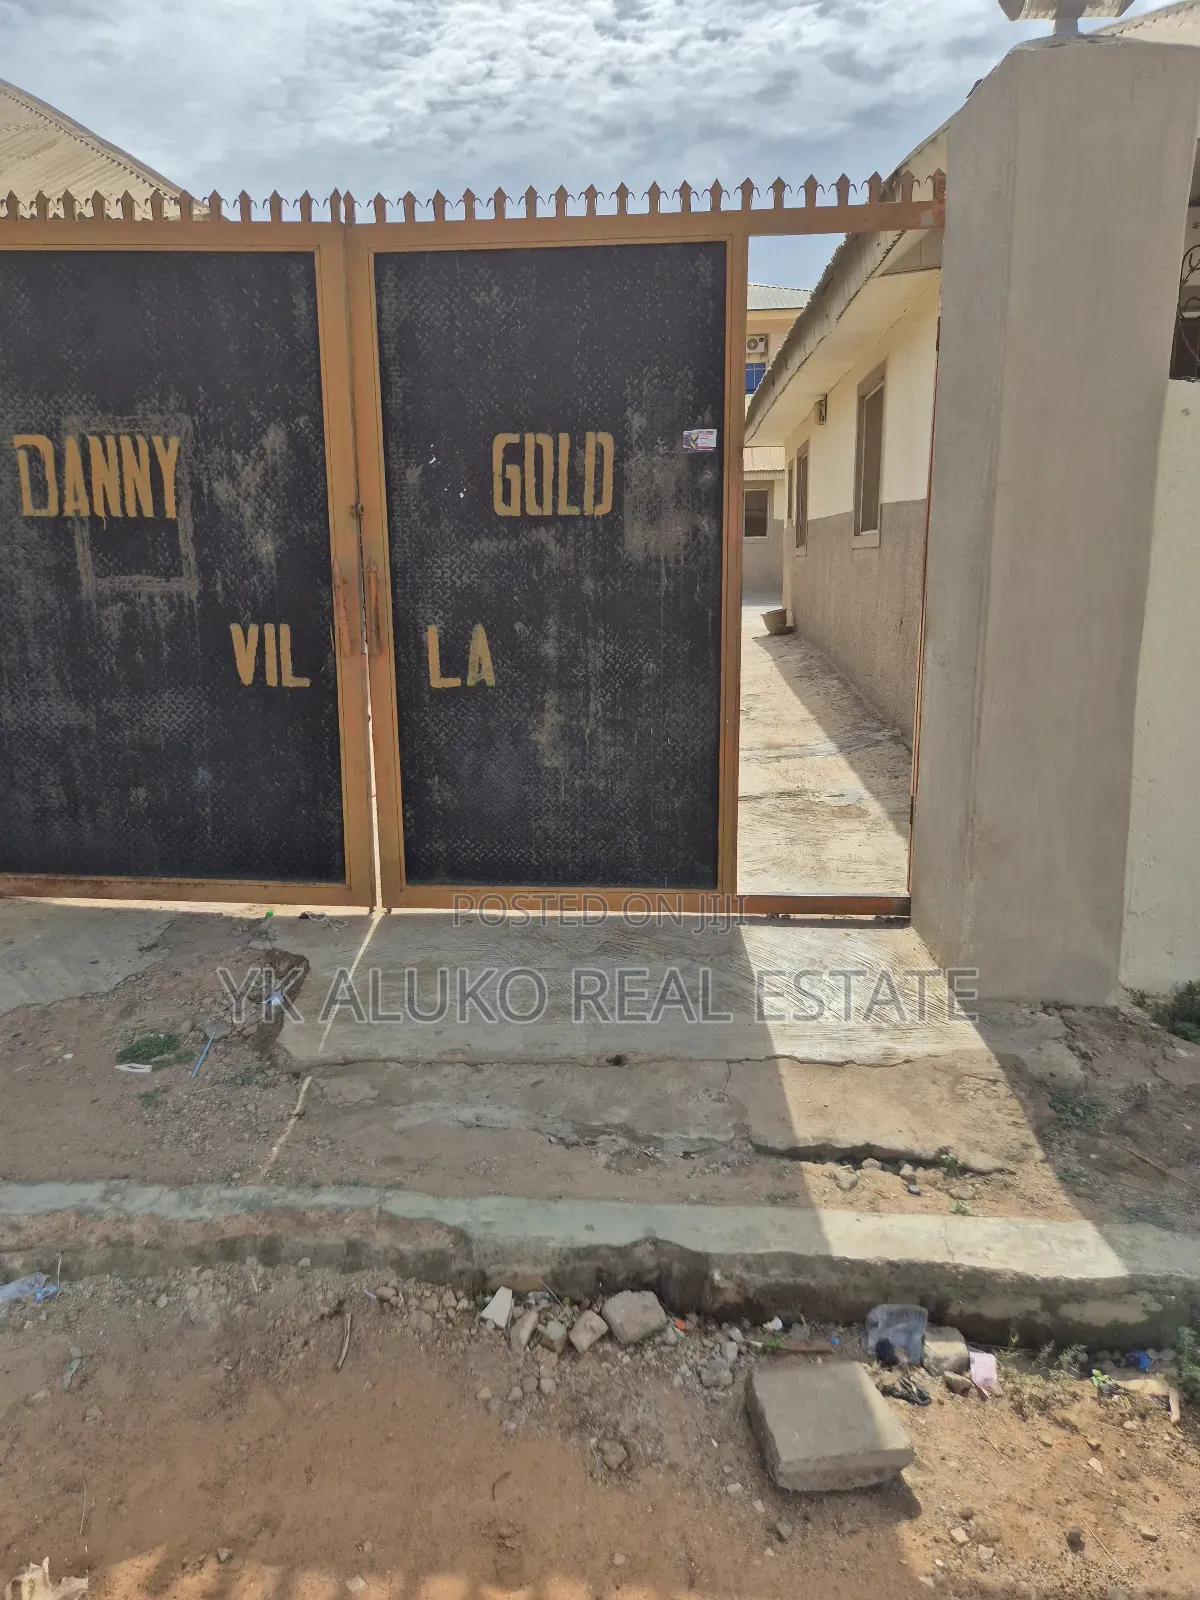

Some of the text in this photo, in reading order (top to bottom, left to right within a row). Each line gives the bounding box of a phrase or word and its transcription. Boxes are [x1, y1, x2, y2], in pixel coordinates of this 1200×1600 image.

[14, 432, 614, 519] DANNY GOLD
[230, 623, 496, 688] VIL LA
